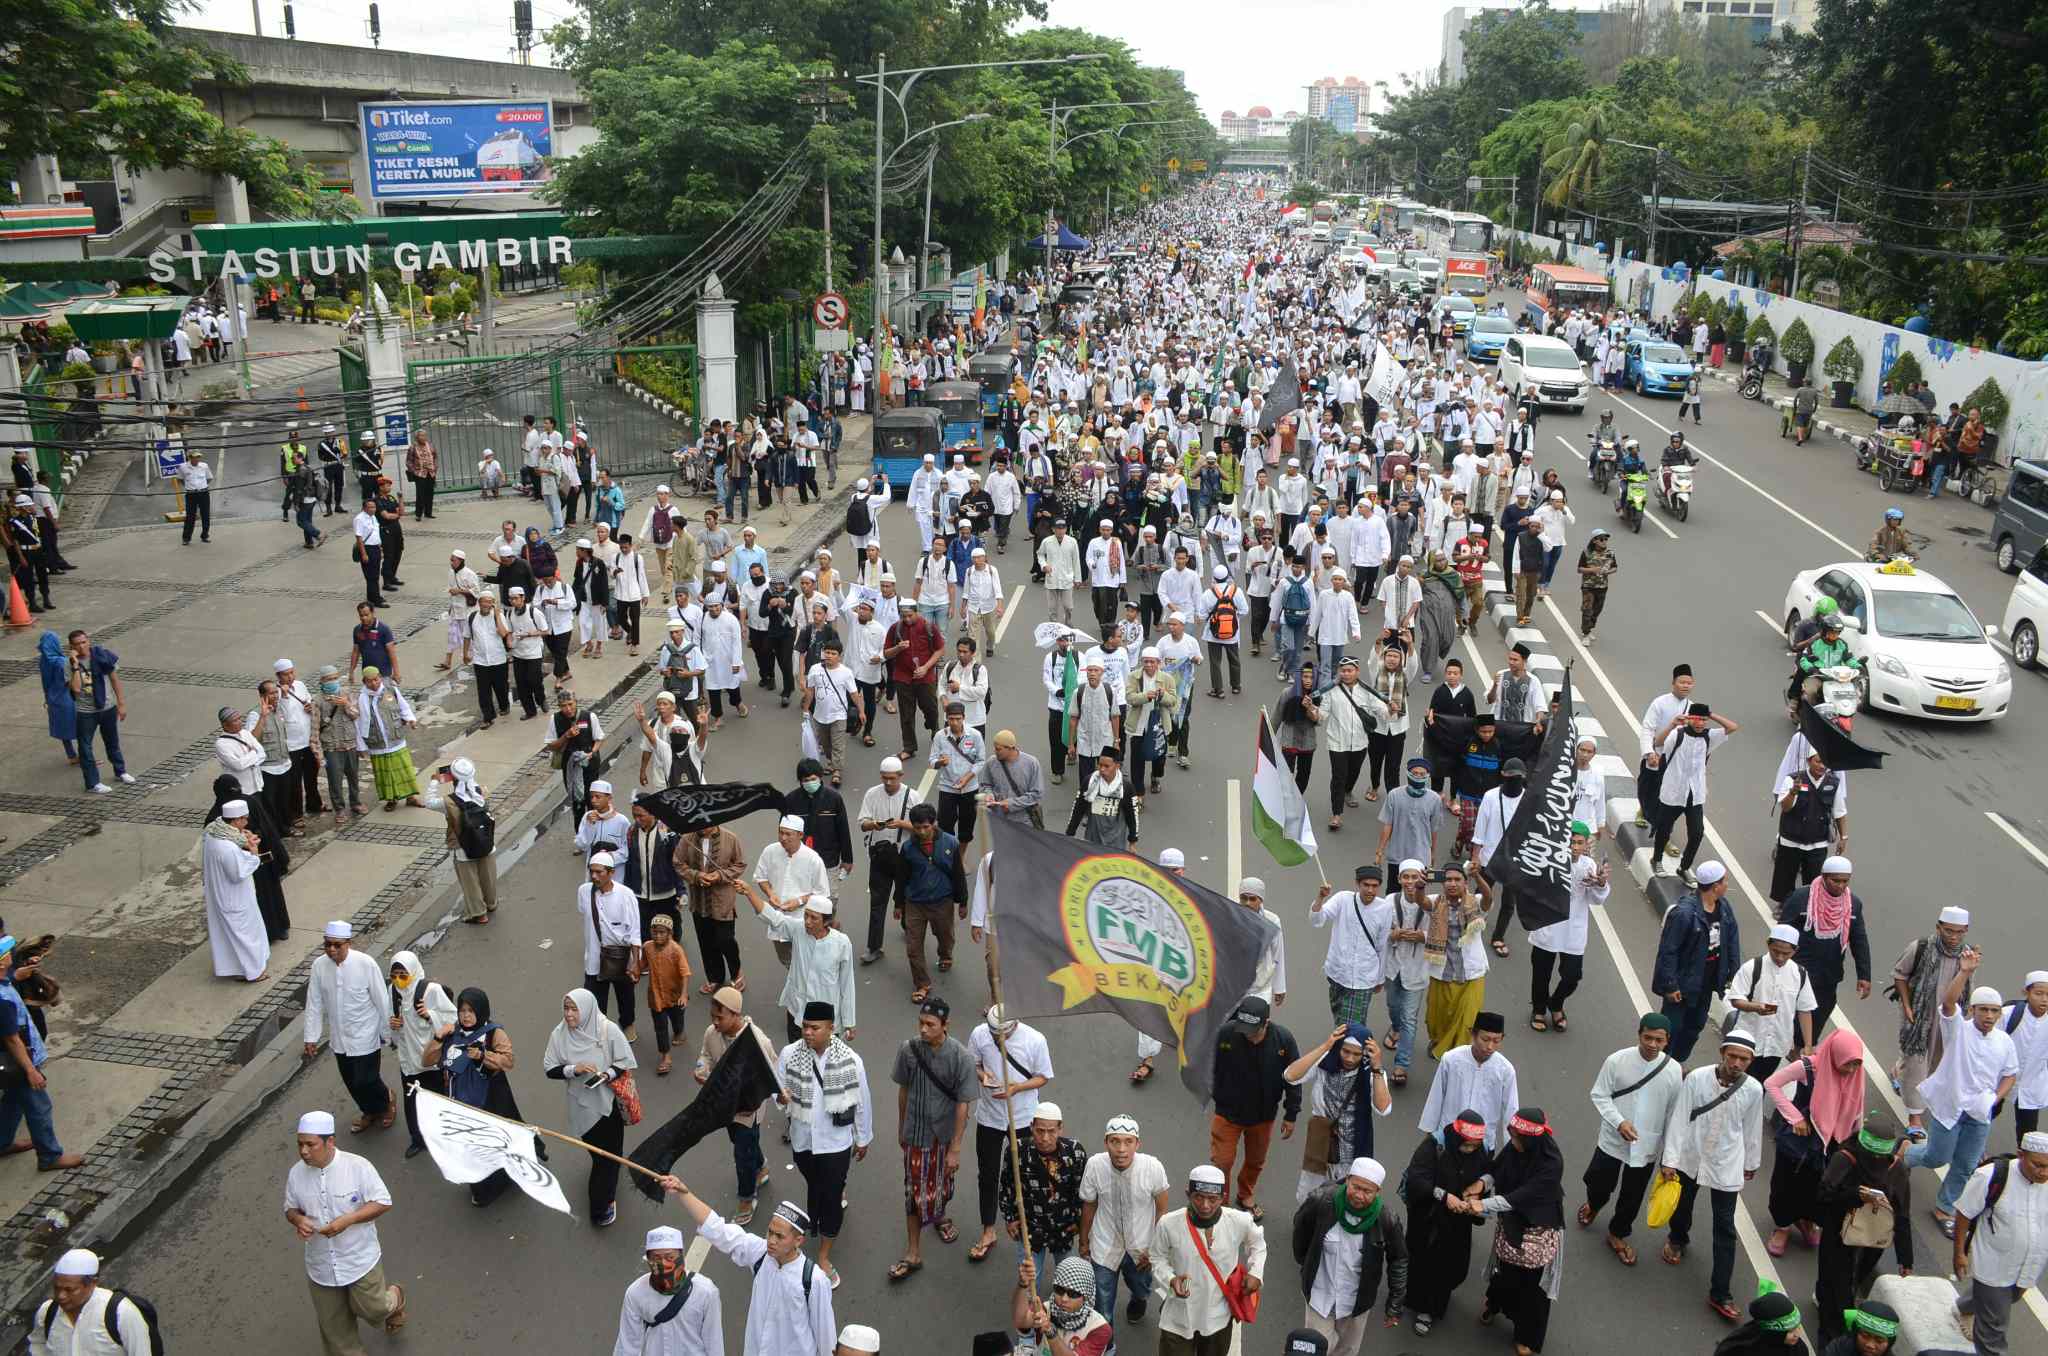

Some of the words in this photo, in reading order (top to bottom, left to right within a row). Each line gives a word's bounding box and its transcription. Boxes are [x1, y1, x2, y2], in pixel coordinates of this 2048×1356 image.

[390, 110, 452, 125] Tiket.com
[375, 158, 414, 168] TIKET
[417, 156, 458, 168] RESMI
[376, 168, 430, 180] KERETA
[432, 167, 476, 179] MUDIK
[149, 244, 369, 283] STASIUN
[394, 235, 573, 272] GAMBIR
[1457, 262, 1476, 271] ACE
[1096, 904, 1189, 980] FMB
